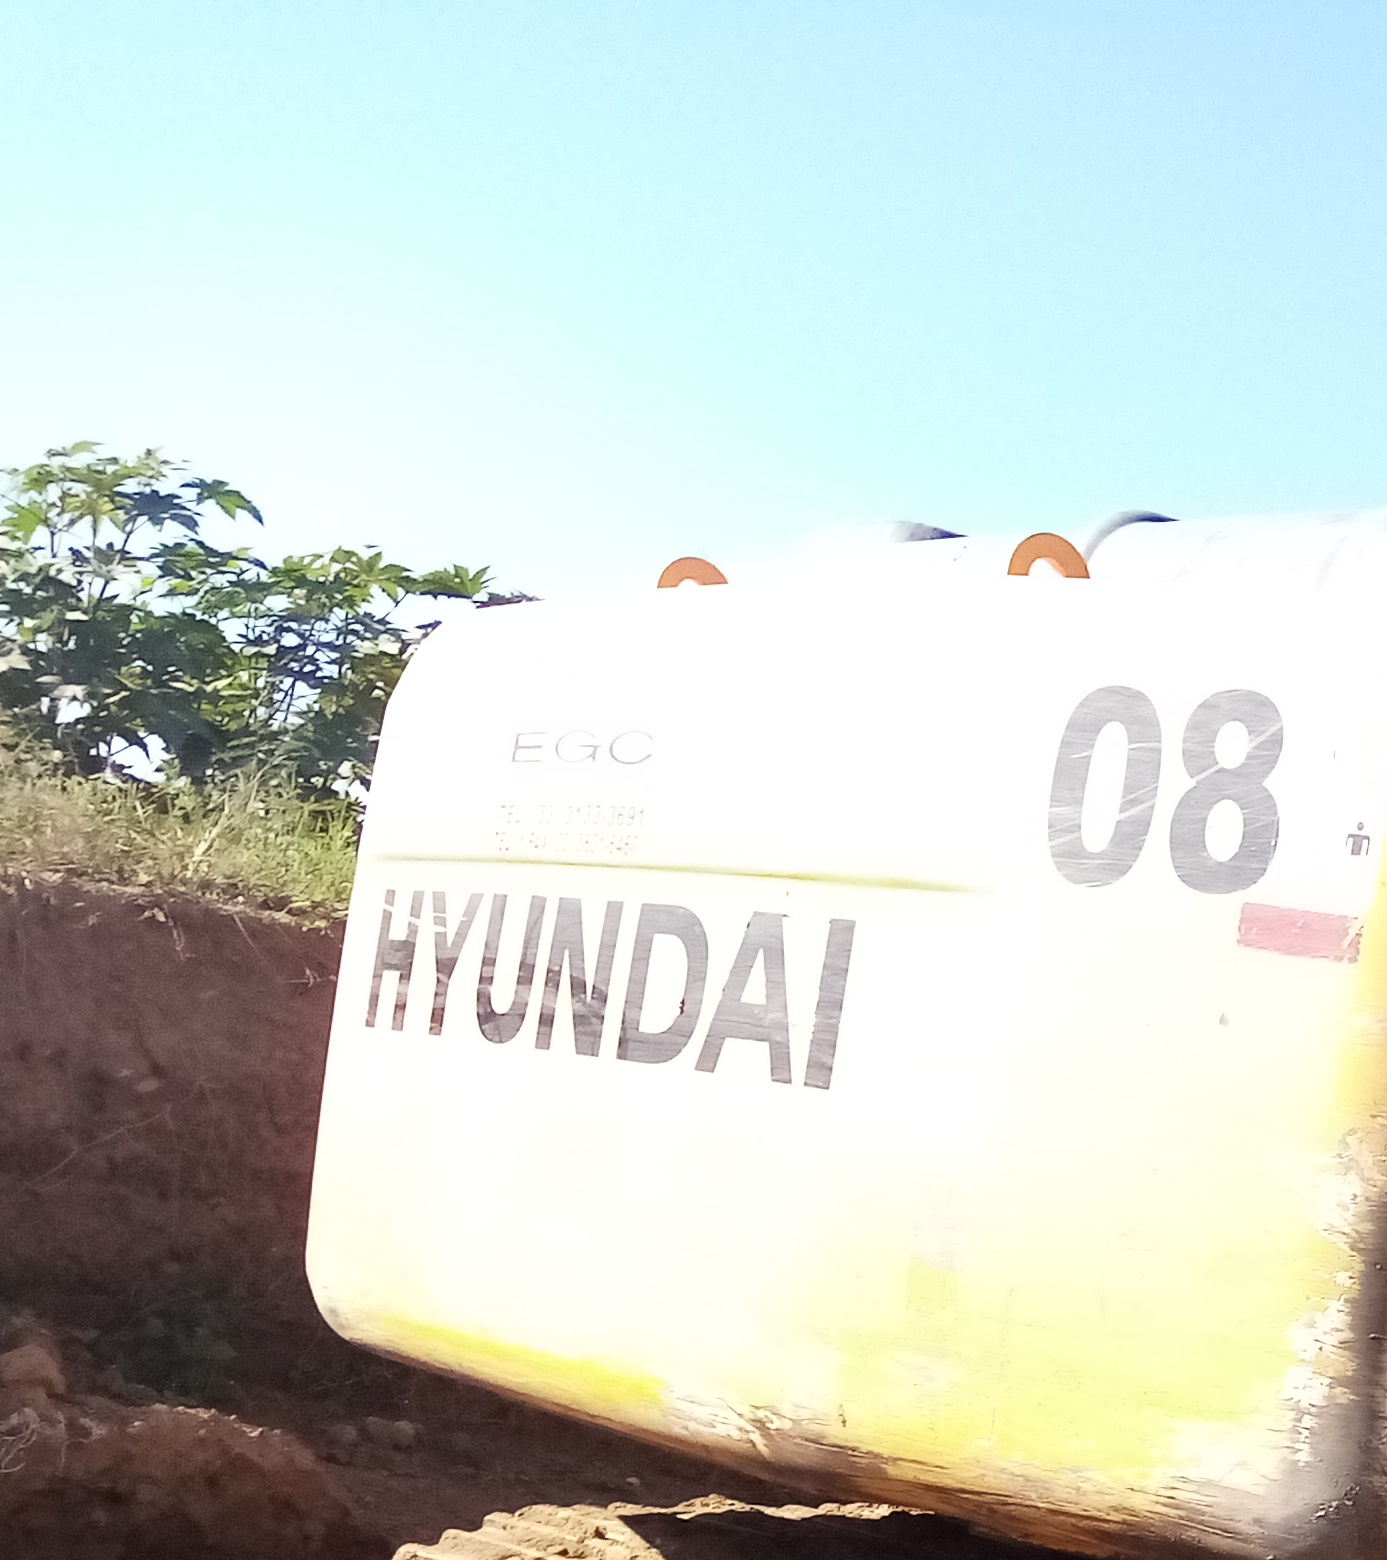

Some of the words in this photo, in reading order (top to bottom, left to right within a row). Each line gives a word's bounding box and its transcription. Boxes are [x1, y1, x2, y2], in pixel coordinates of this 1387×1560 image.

[512, 730, 654, 765] EGC
[1047, 685, 1284, 895] 08
[365, 888, 857, 1090] HYUNDAI
